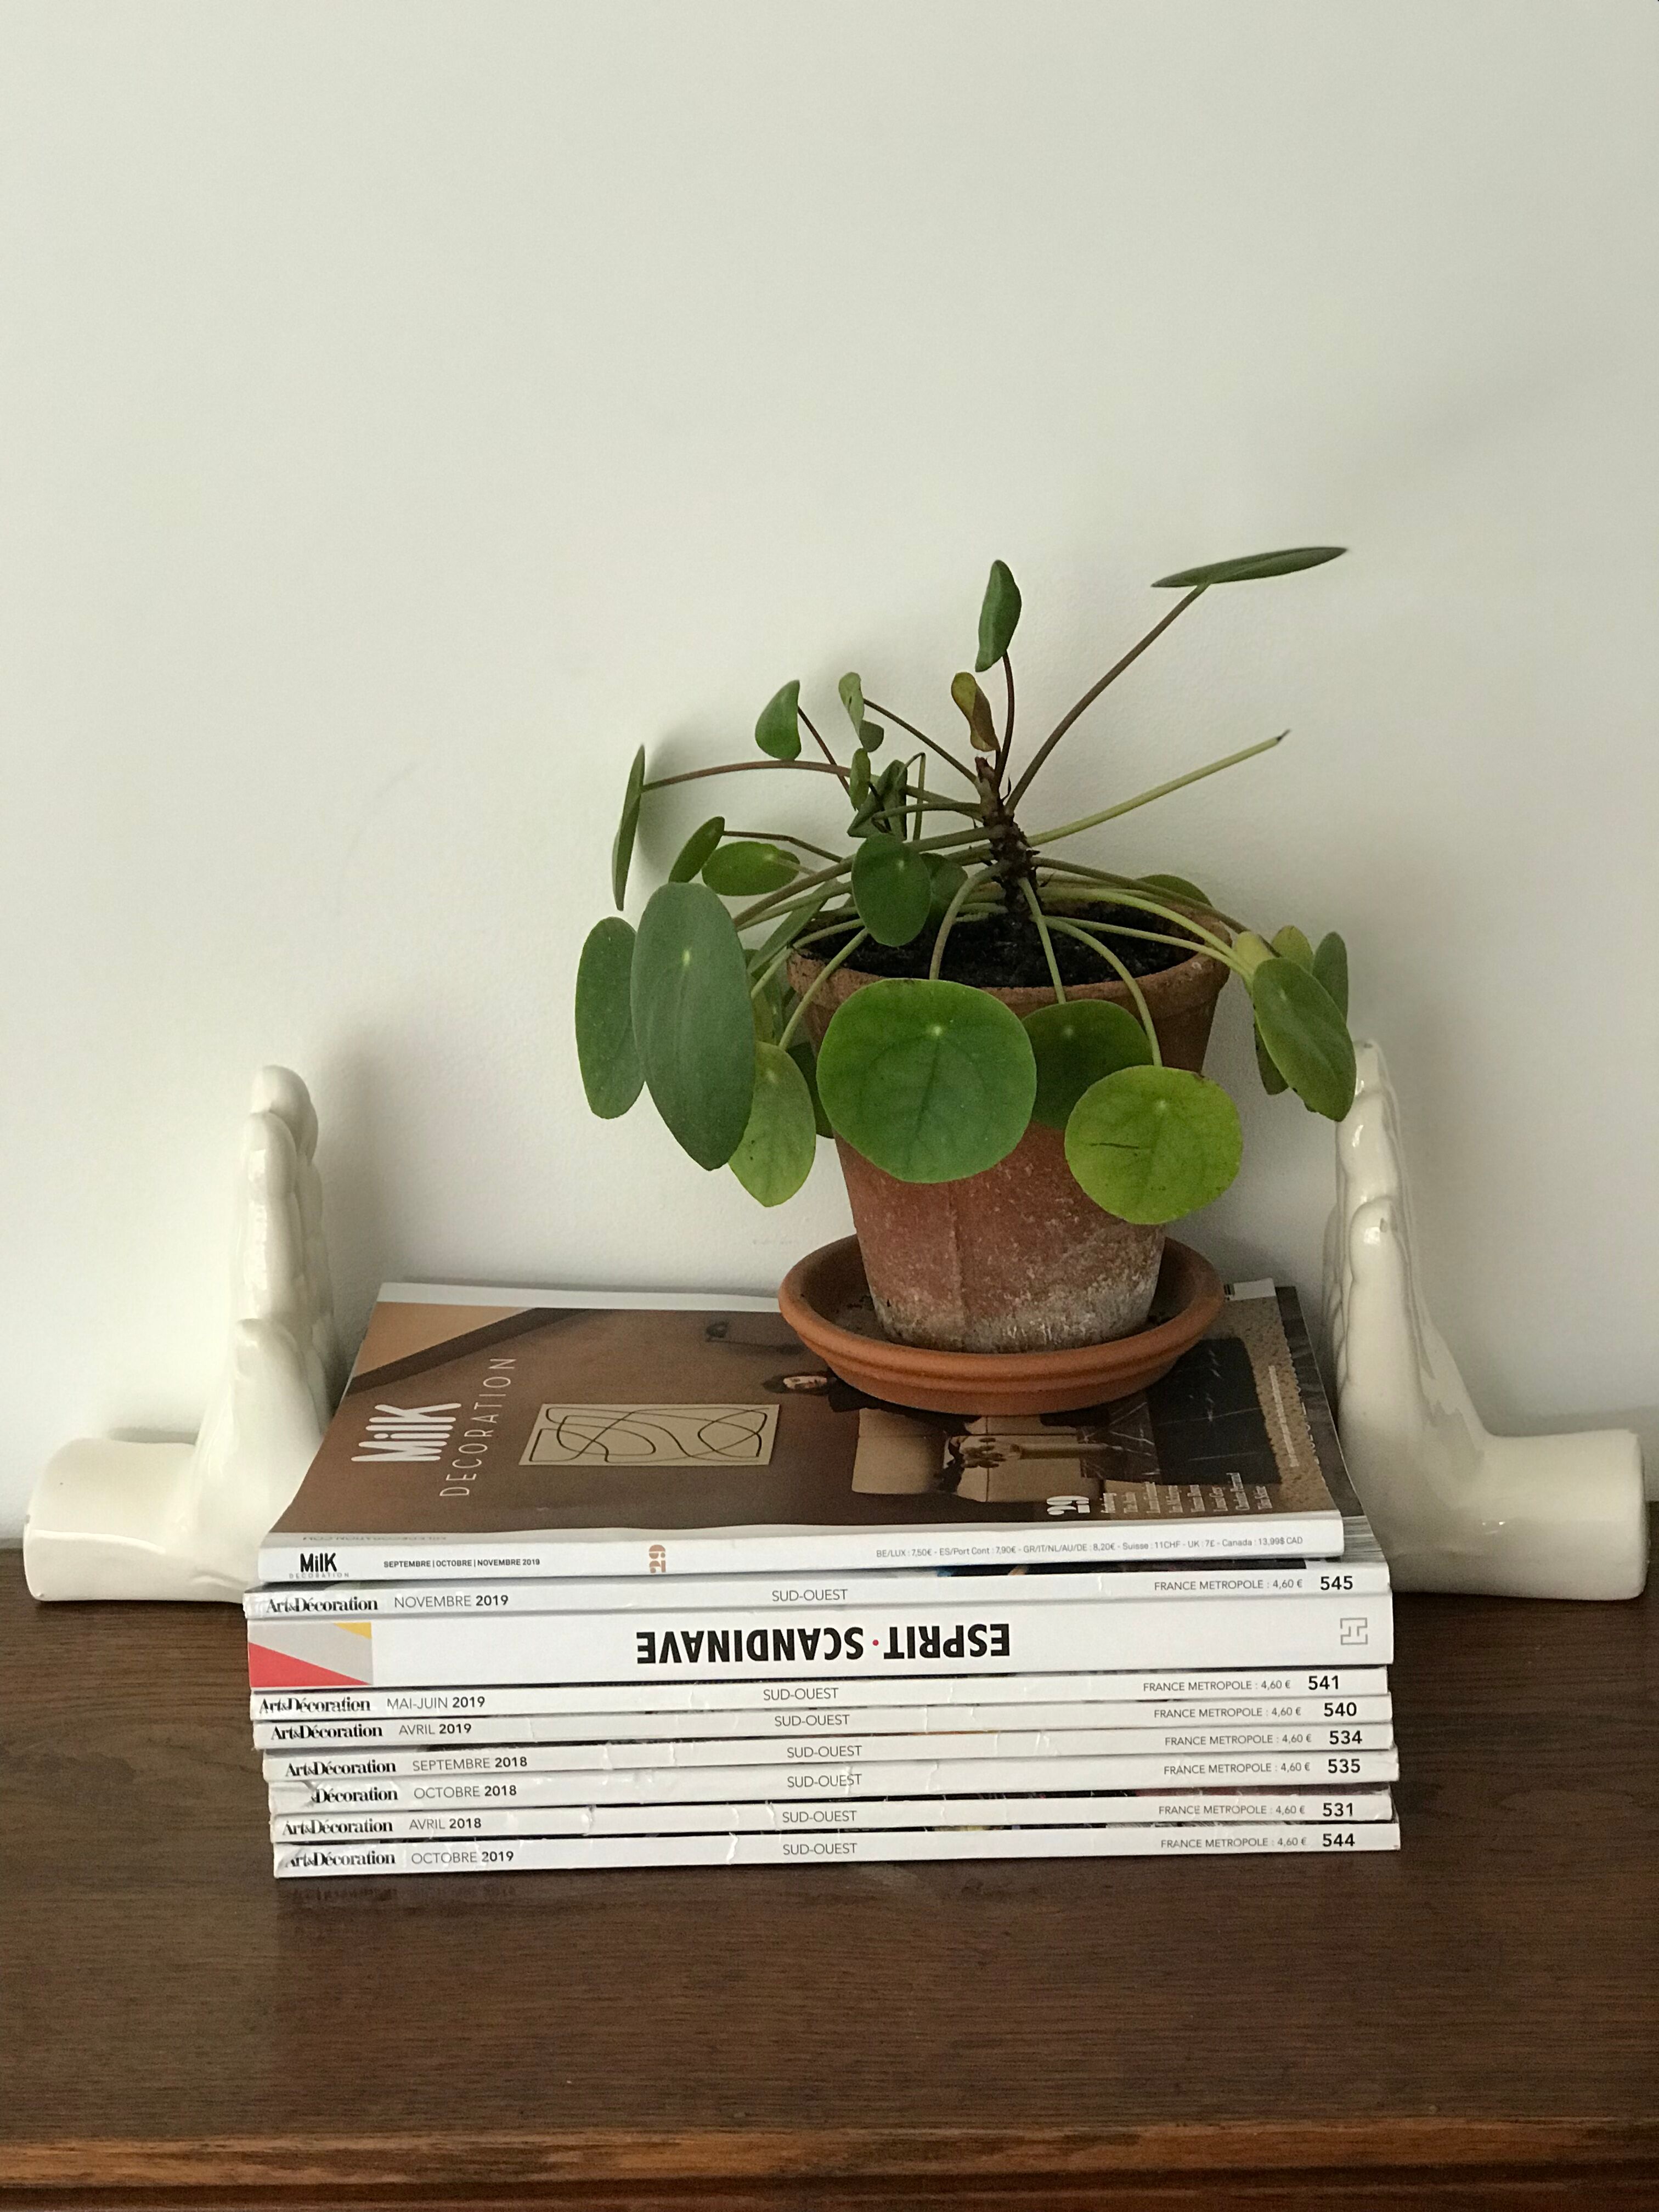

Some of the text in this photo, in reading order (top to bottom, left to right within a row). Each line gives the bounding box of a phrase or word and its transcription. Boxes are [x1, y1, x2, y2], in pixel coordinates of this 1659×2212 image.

[351, 1402, 462, 1462] MilK
[439, 1357, 517, 1497] DECORATION
[1046, 1495, 1091, 1516] 29
[300, 1552, 337, 1573] MilK
[383, 1560, 431, 1568] SEPTEMBRE
[436, 1559, 472, 1567] OCTOBRE
[648, 1544, 666, 1573] 29
[876, 1549, 906, 1558] BE/LUX
[911, 1548, 932, 1558] 7,50€
[939, 1547, 970, 1556] ES/Port
[971, 1547, 990, 1555] Cont
[996, 1545, 1016, 1555] 7,90€
[1023, 1543, 1087, 1554] GR/IT/NL/AU/DE
[1093, 1542, 1115, 1551] 8,20€
[1122, 1542, 1149, 1550] Suisse
[1154, 1540, 1181, 1549] 11CHF
[1187, 1540, 1200, 1548] UK
[1222, 1538, 1252, 1547] Canada
[1286, 1536, 1304, 1545] CAD
[394, 1595, 472, 1609] NOVEMBRE
[476, 1594, 509, 1606] 2019
[771, 1588, 849, 1602] SUD-OUEST
[1154, 1581, 1197, 1591] FRANCE
[1199, 1579, 1264, 1590] METROPOLE
[1272, 1579, 1294, 1590] 4,60
[1296, 1579, 1302, 1588] €
[1320, 1575, 1353, 1591] 545
[636, 1623, 1010, 1664] ESPRIT SCANDINAVE
[387, 1697, 448, 1709] MAI-JUIN
[452, 1696, 485, 1708] 2019
[763, 1687, 839, 1701] SUD-OUEST
[1143, 1681, 1185, 1692] FRANCE
[1188, 1680, 1252, 1691] METROPOLE
[1261, 1680, 1282, 1691] 4,60
[1285, 1680, 1291, 1689] €
[1308, 1675, 1339, 1690] 541
[398, 1724, 436, 1735] AVRIL
[439, 1723, 472, 1734] 2019
[774, 1714, 850, 1727] SUD-OUEST
[1154, 1708, 1195, 1718] FRANCE
[1199, 1707, 1262, 1718] METROPOLE
[1271, 1707, 1293, 1718] 4,60
[1295, 1707, 1301, 1716] €
[1324, 1702, 1357, 1717] 540
[412, 1757, 491, 1772] SEPTEMBRE
[494, 1756, 528, 1768] 2018
[787, 1745, 862, 1758] SUD-OUEST
[1165, 1736, 1206, 1746] FRANCE
[1209, 1734, 1273, 1745] METROPOLE
[1282, 1734, 1304, 1744] 4,60
[1306, 1734, 1311, 1743] €
[1329, 1730, 1363, 1745] 534
[414, 1786, 481, 1799] OCTOBRE
[484, 1785, 517, 1797] 2018
[787, 1773, 862, 1788] SUD-OUEST
[1164, 1764, 1206, 1775] FRANCE
[1208, 1763, 1272, 1774] METROPOLE
[1280, 1762, 1302, 1773] 4,60
[1304, 1762, 1310, 1771] €
[1328, 1758, 1361, 1774] 535
[409, 1819, 445, 1830] AVRIL
[449, 1818, 482, 1829] 2018
[782, 1810, 857, 1824] SUD-OUEST
[1159, 1805, 1200, 1815] FRANCE
[1203, 1805, 1267, 1814] METROPOLE
[1276, 1805, 1297, 1815] 4,60
[1299, 1805, 1305, 1814] €
[1322, 1802, 1353, 1817] 531
[411, 1852, 478, 1865] OCTOBRE
[482, 1850, 514, 1863] 2019
[782, 1842, 857, 1855] SUD-OUEST
[1161, 1839, 1202, 1848] FRANCE
[1205, 1837, 1268, 1848] METROPOLE
[1277, 1837, 1299, 1847] 4,60
[1300, 1837, 1306, 1846] €
[1322, 1833, 1356, 1847] 544
